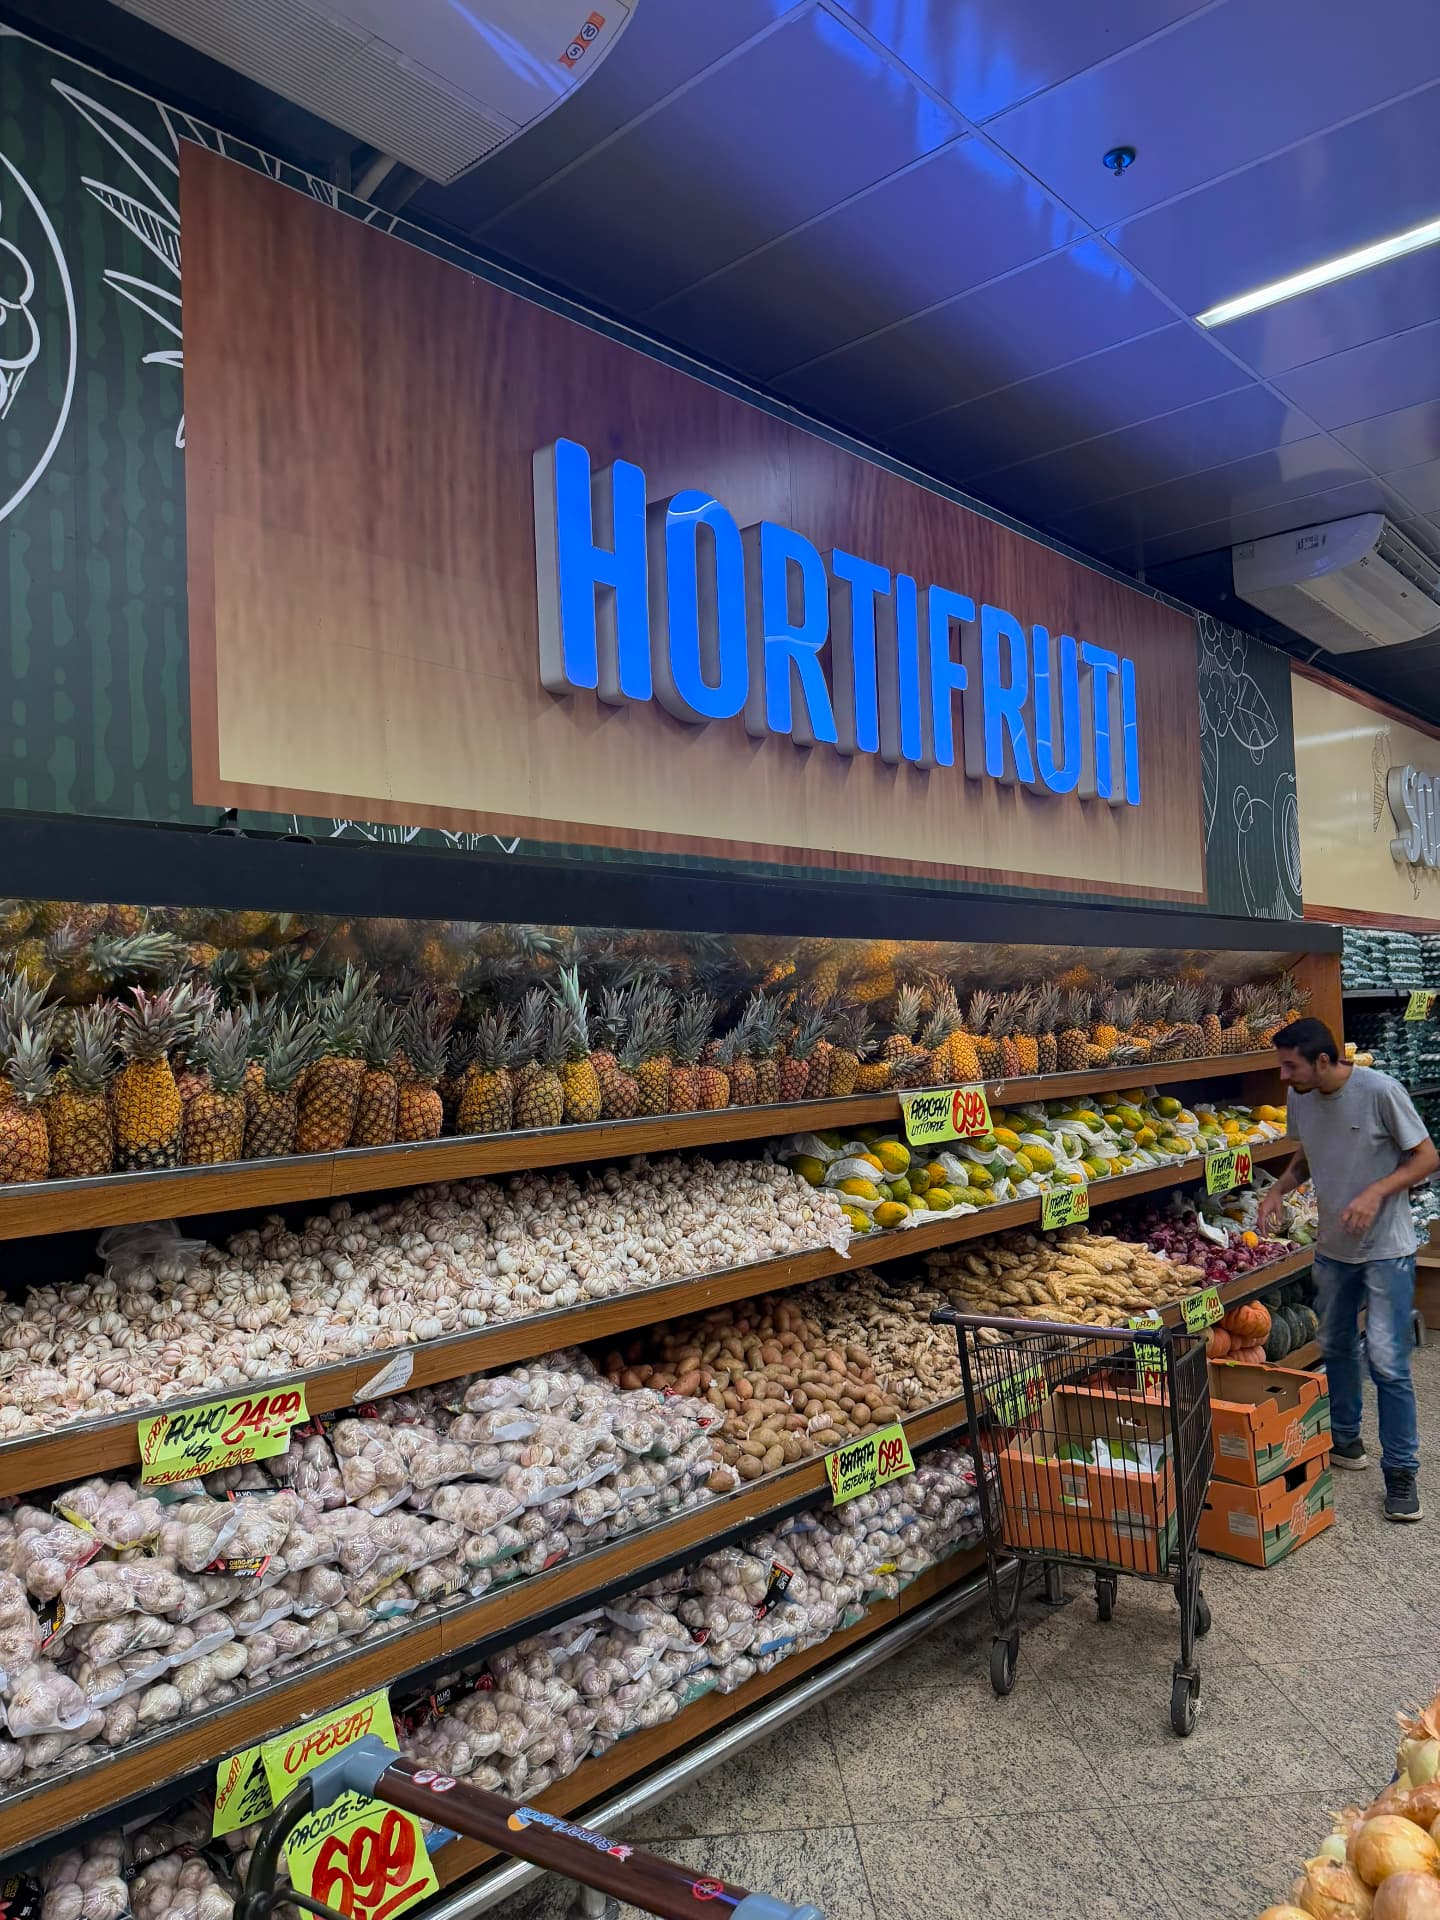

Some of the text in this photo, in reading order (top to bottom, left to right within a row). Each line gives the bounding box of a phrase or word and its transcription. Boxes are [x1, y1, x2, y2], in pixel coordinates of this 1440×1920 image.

[570, 47, 580, 57] 5
[583, 25, 596, 38] 10
[536, 437, 1140, 807] HORTIFRUTI
[144, 1414, 168, 1466] OFERTA
[163, 1391, 302, 1447] ALHO 24,99
[840, 1437, 904, 1478] BATATA 6,99
[284, 1706, 373, 1774] OFERTA
[216, 1756, 242, 1810] OFERTA
